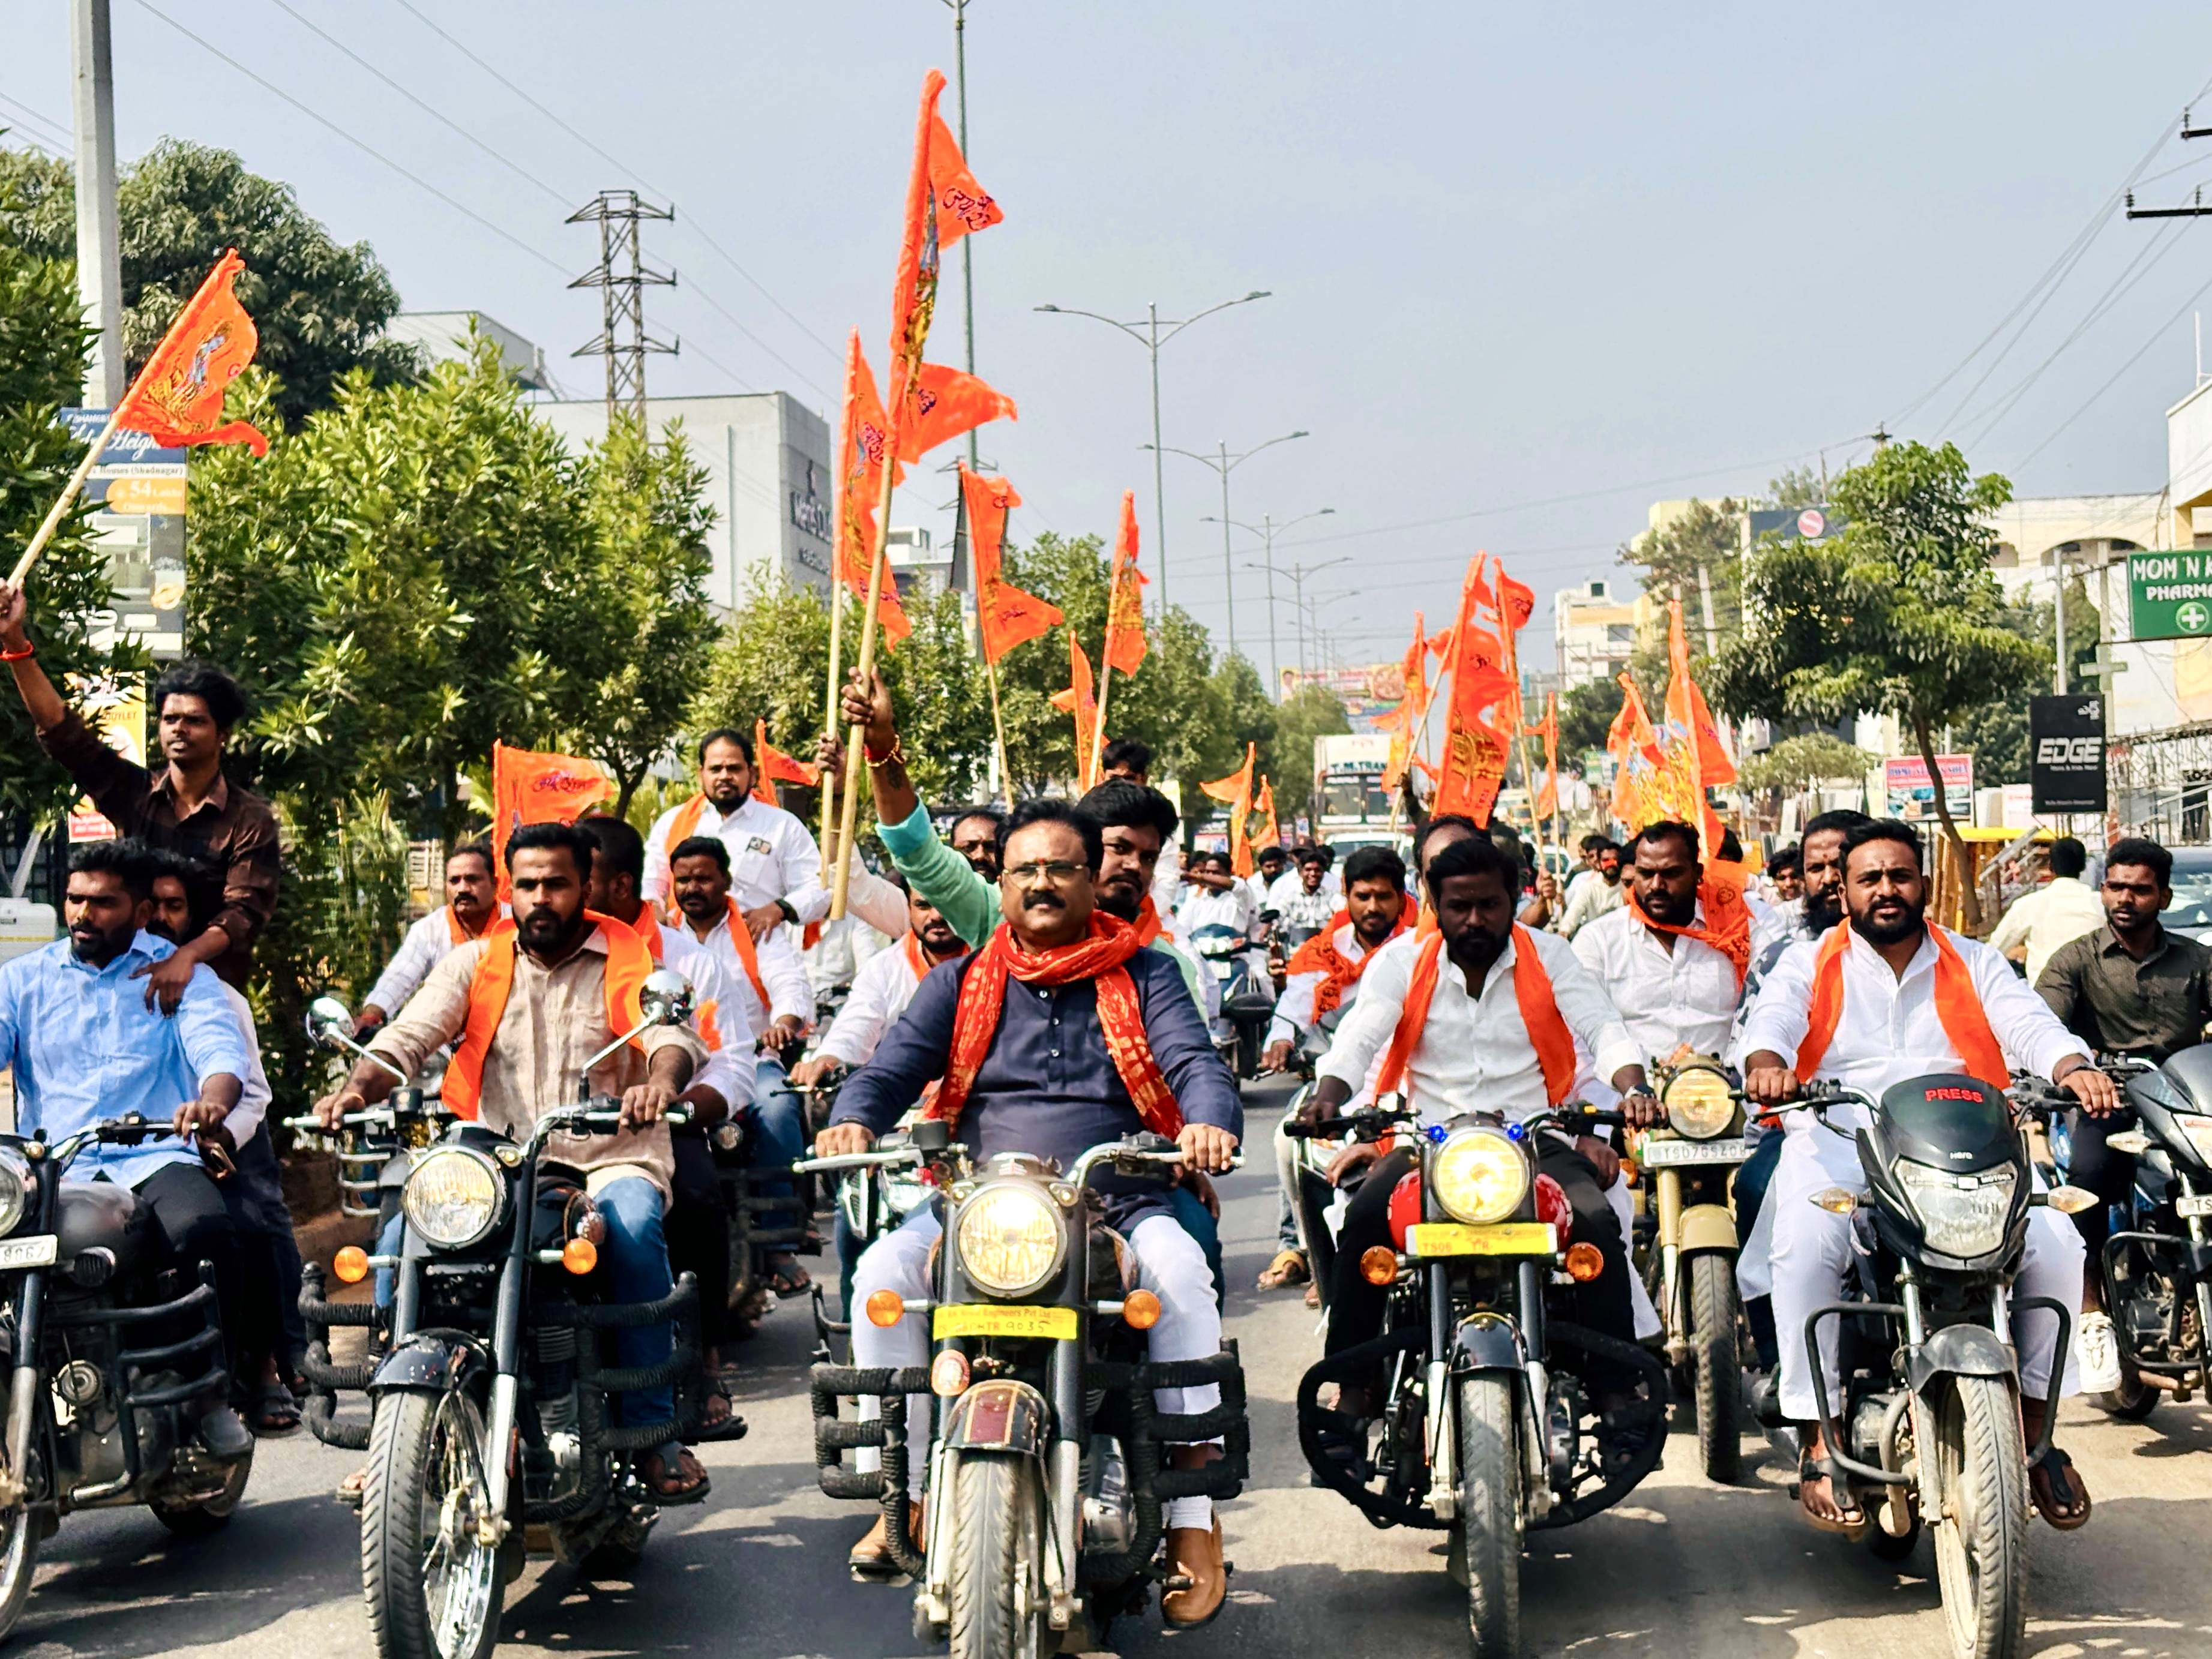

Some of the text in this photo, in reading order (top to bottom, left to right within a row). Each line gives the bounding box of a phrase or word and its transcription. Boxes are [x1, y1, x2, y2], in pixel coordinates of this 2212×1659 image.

[129, 480, 151, 497] 54
[2132, 557, 2177, 582] MOM
[2037, 736, 2102, 764] EDGE
[1925, 1087, 1985, 1103] PRESS
[1950, 1151, 1973, 1160] Hero
[2195, 1200, 2212, 1211] TS
